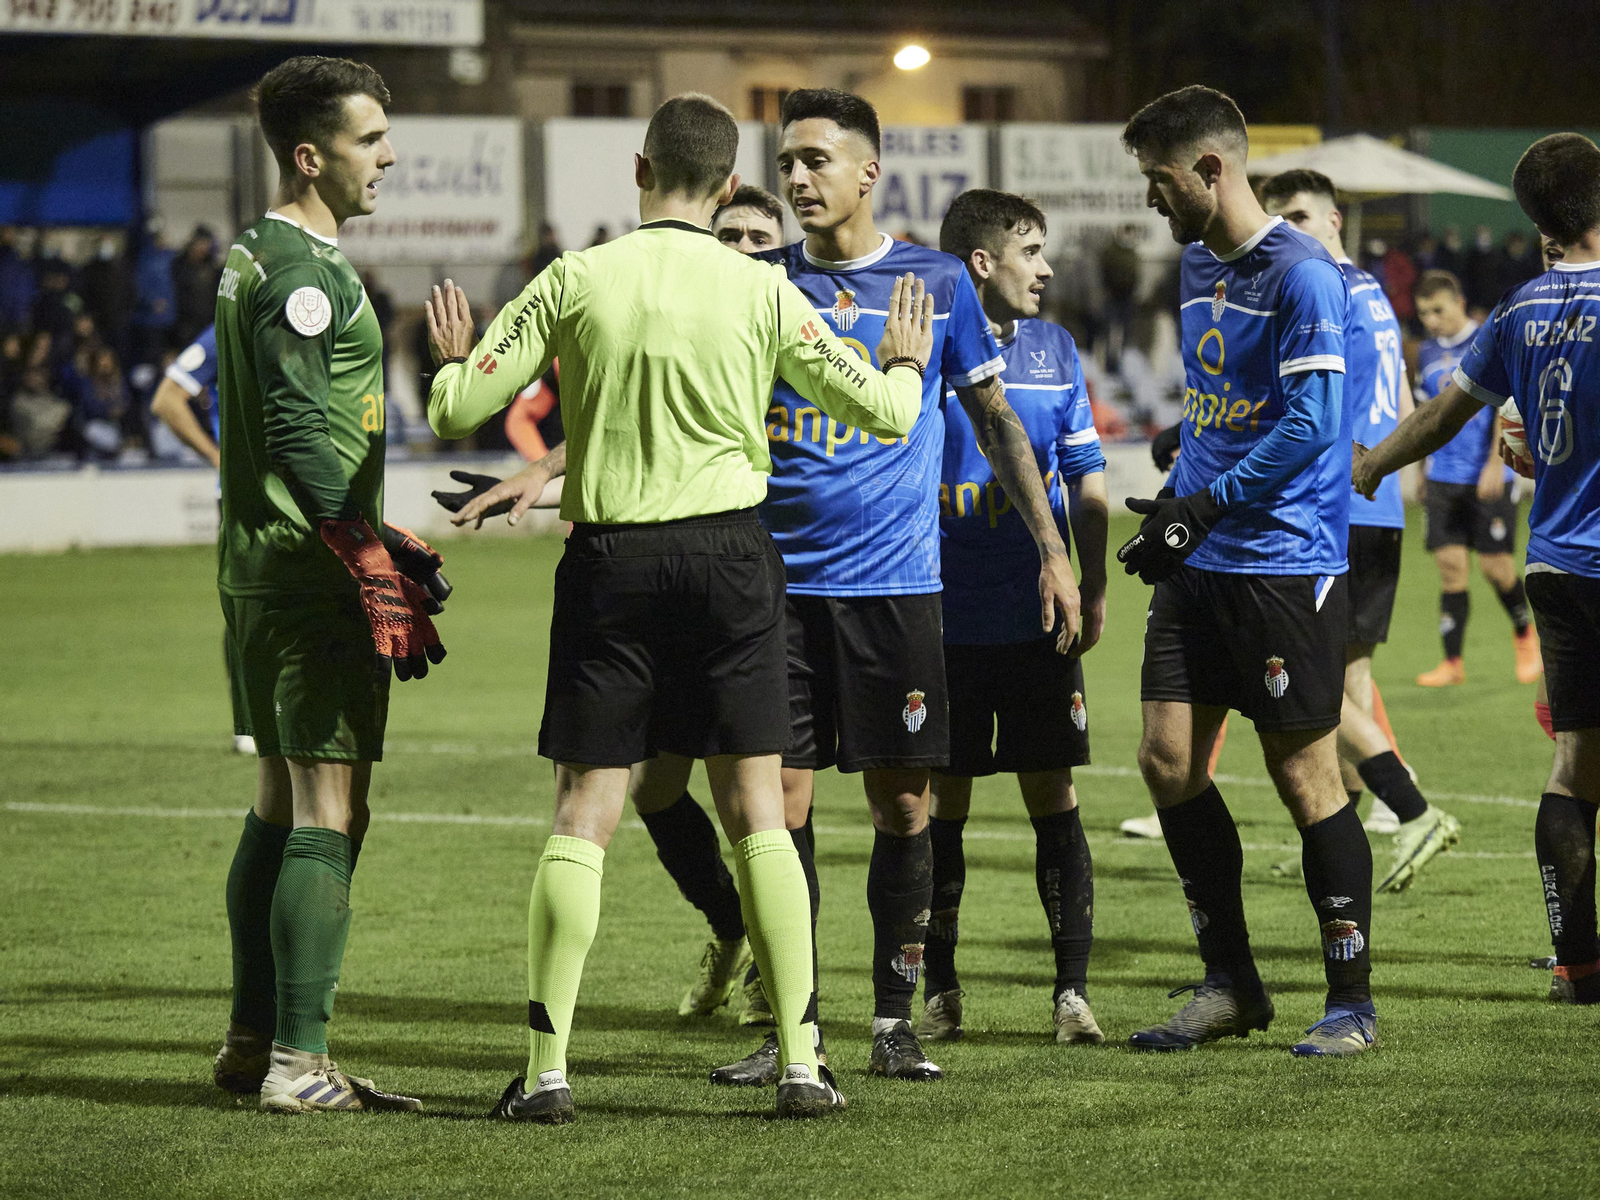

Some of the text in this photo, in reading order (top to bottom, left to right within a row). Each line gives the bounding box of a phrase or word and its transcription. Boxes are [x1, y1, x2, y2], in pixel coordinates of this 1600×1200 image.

[493, 294, 543, 356] WÜRTH
[813, 338, 867, 390] WÜRTH
[1538, 356, 1574, 466] 6
